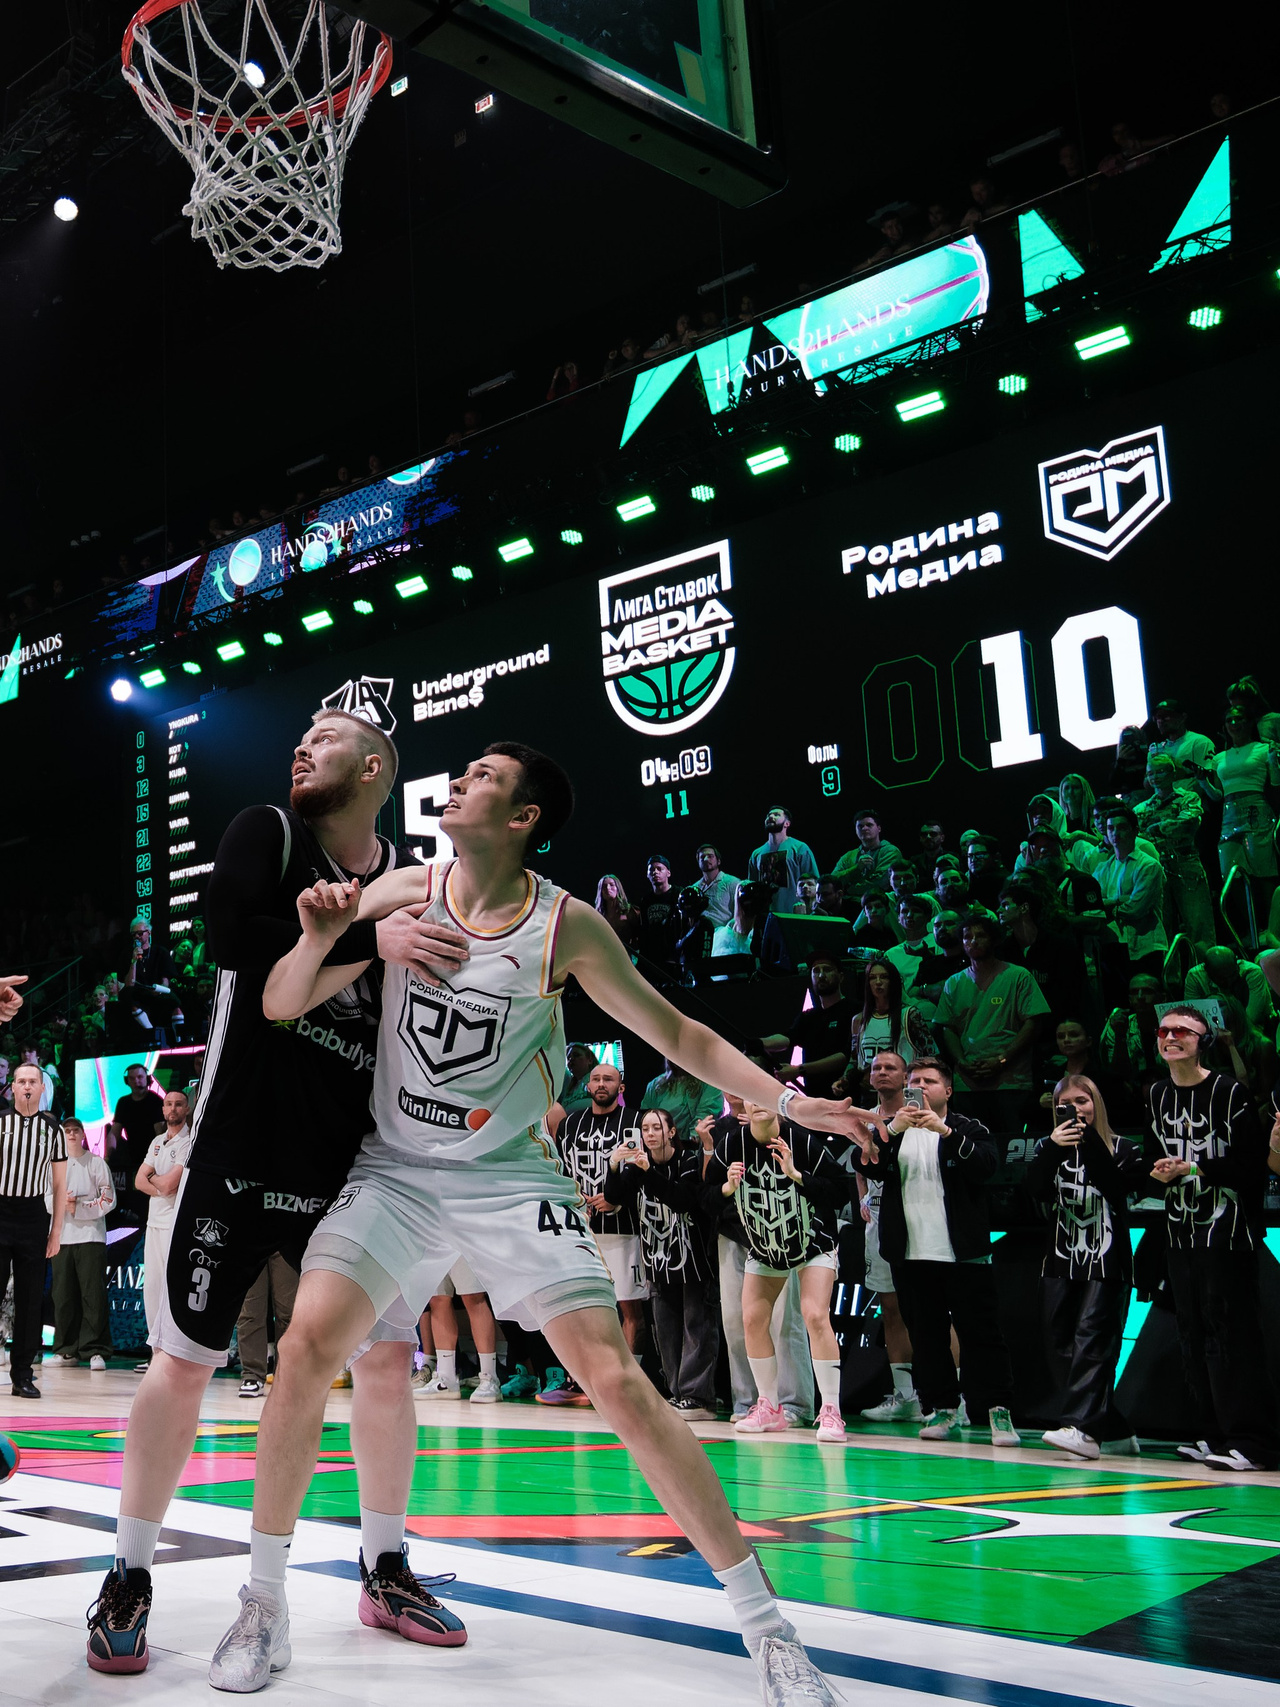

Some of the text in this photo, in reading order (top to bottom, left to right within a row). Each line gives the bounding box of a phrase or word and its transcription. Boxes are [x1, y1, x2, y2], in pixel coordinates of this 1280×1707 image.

[822, 325, 913, 370] RESALE
[1049, 445, 1154, 485] РОДИНА МЕДИА
[271, 501, 393, 565] HANDS2HANDS
[841, 511, 1000, 574] Родина
[866, 544, 1003, 599] Медиа
[601, 598, 733, 655] MEDIA
[23, 655, 62, 676] RESALE
[602, 622, 734, 677] BASKET
[412, 643, 550, 700] Underground
[980, 605, 1149, 768] 10
[413, 685, 484, 722] Bizne$
[136, 755, 145, 773] 3
[641, 745, 711, 787] 04:09
[821, 766, 841, 796] 9
[136, 778, 149, 798] 12
[664, 789, 690, 819] 11
[136, 803, 149, 823] 15
[403, 772, 454, 865] 5
[136, 828, 149, 848] 21
[136, 853, 151, 873] 22
[169, 862, 215, 881] SHATTERPROO
[136, 877, 153, 897] 43
[409, 979, 499, 1017] РОДИНА МЕДИА
[401, 1090, 460, 1126] Winline
[263, 1192, 328, 1214] BIZNE
[538, 1200, 586, 1238] 44
[188, 1267, 211, 1312] 3
